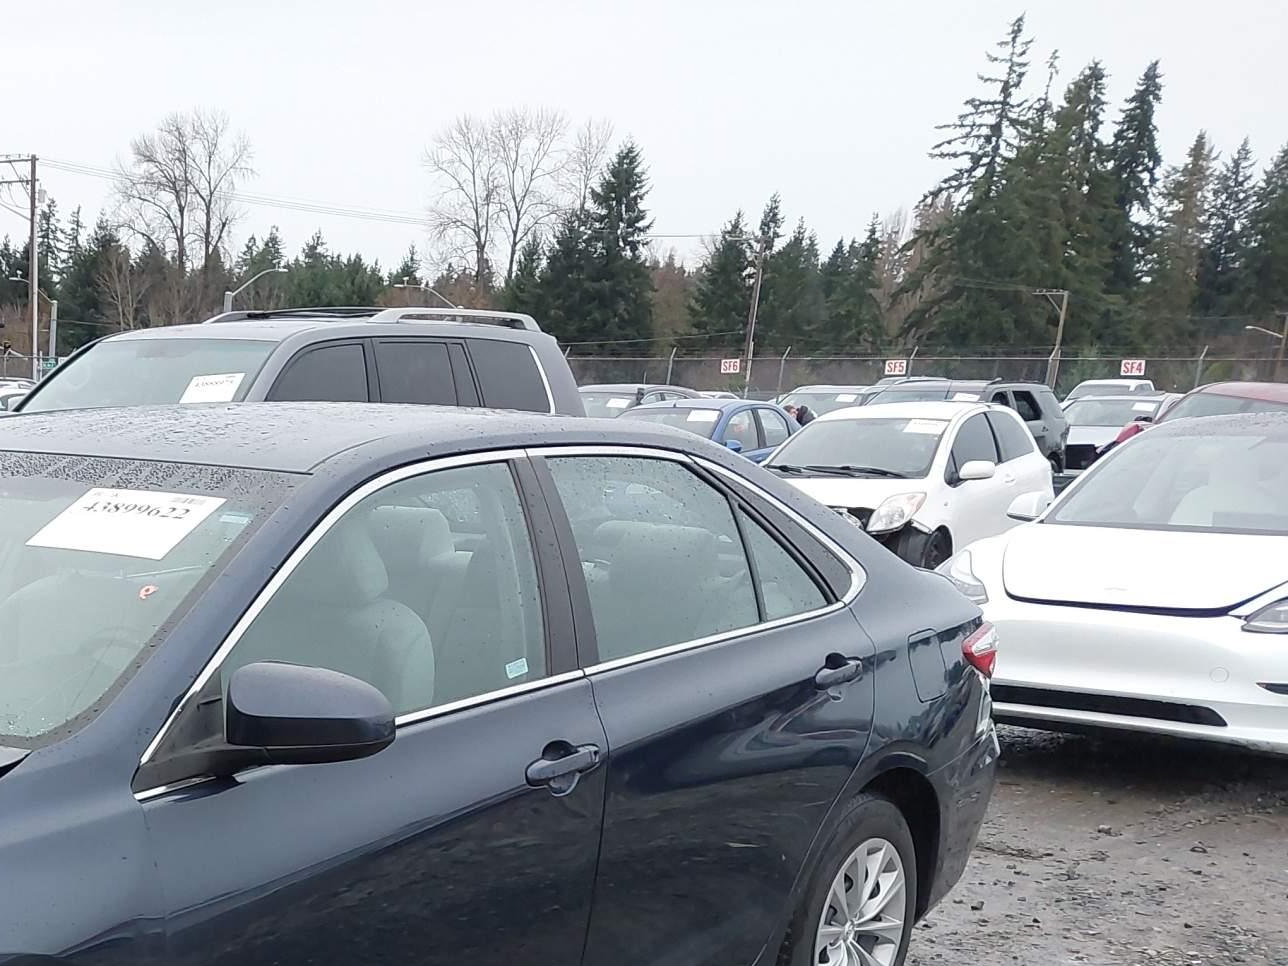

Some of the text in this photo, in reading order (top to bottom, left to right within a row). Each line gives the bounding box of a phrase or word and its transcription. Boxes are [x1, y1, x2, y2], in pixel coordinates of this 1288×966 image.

[722, 360, 738, 372] SF6
[887, 361, 905, 373] SF5
[1122, 361, 1143, 374] SF4
[82, 501, 191, 520] 43899622
